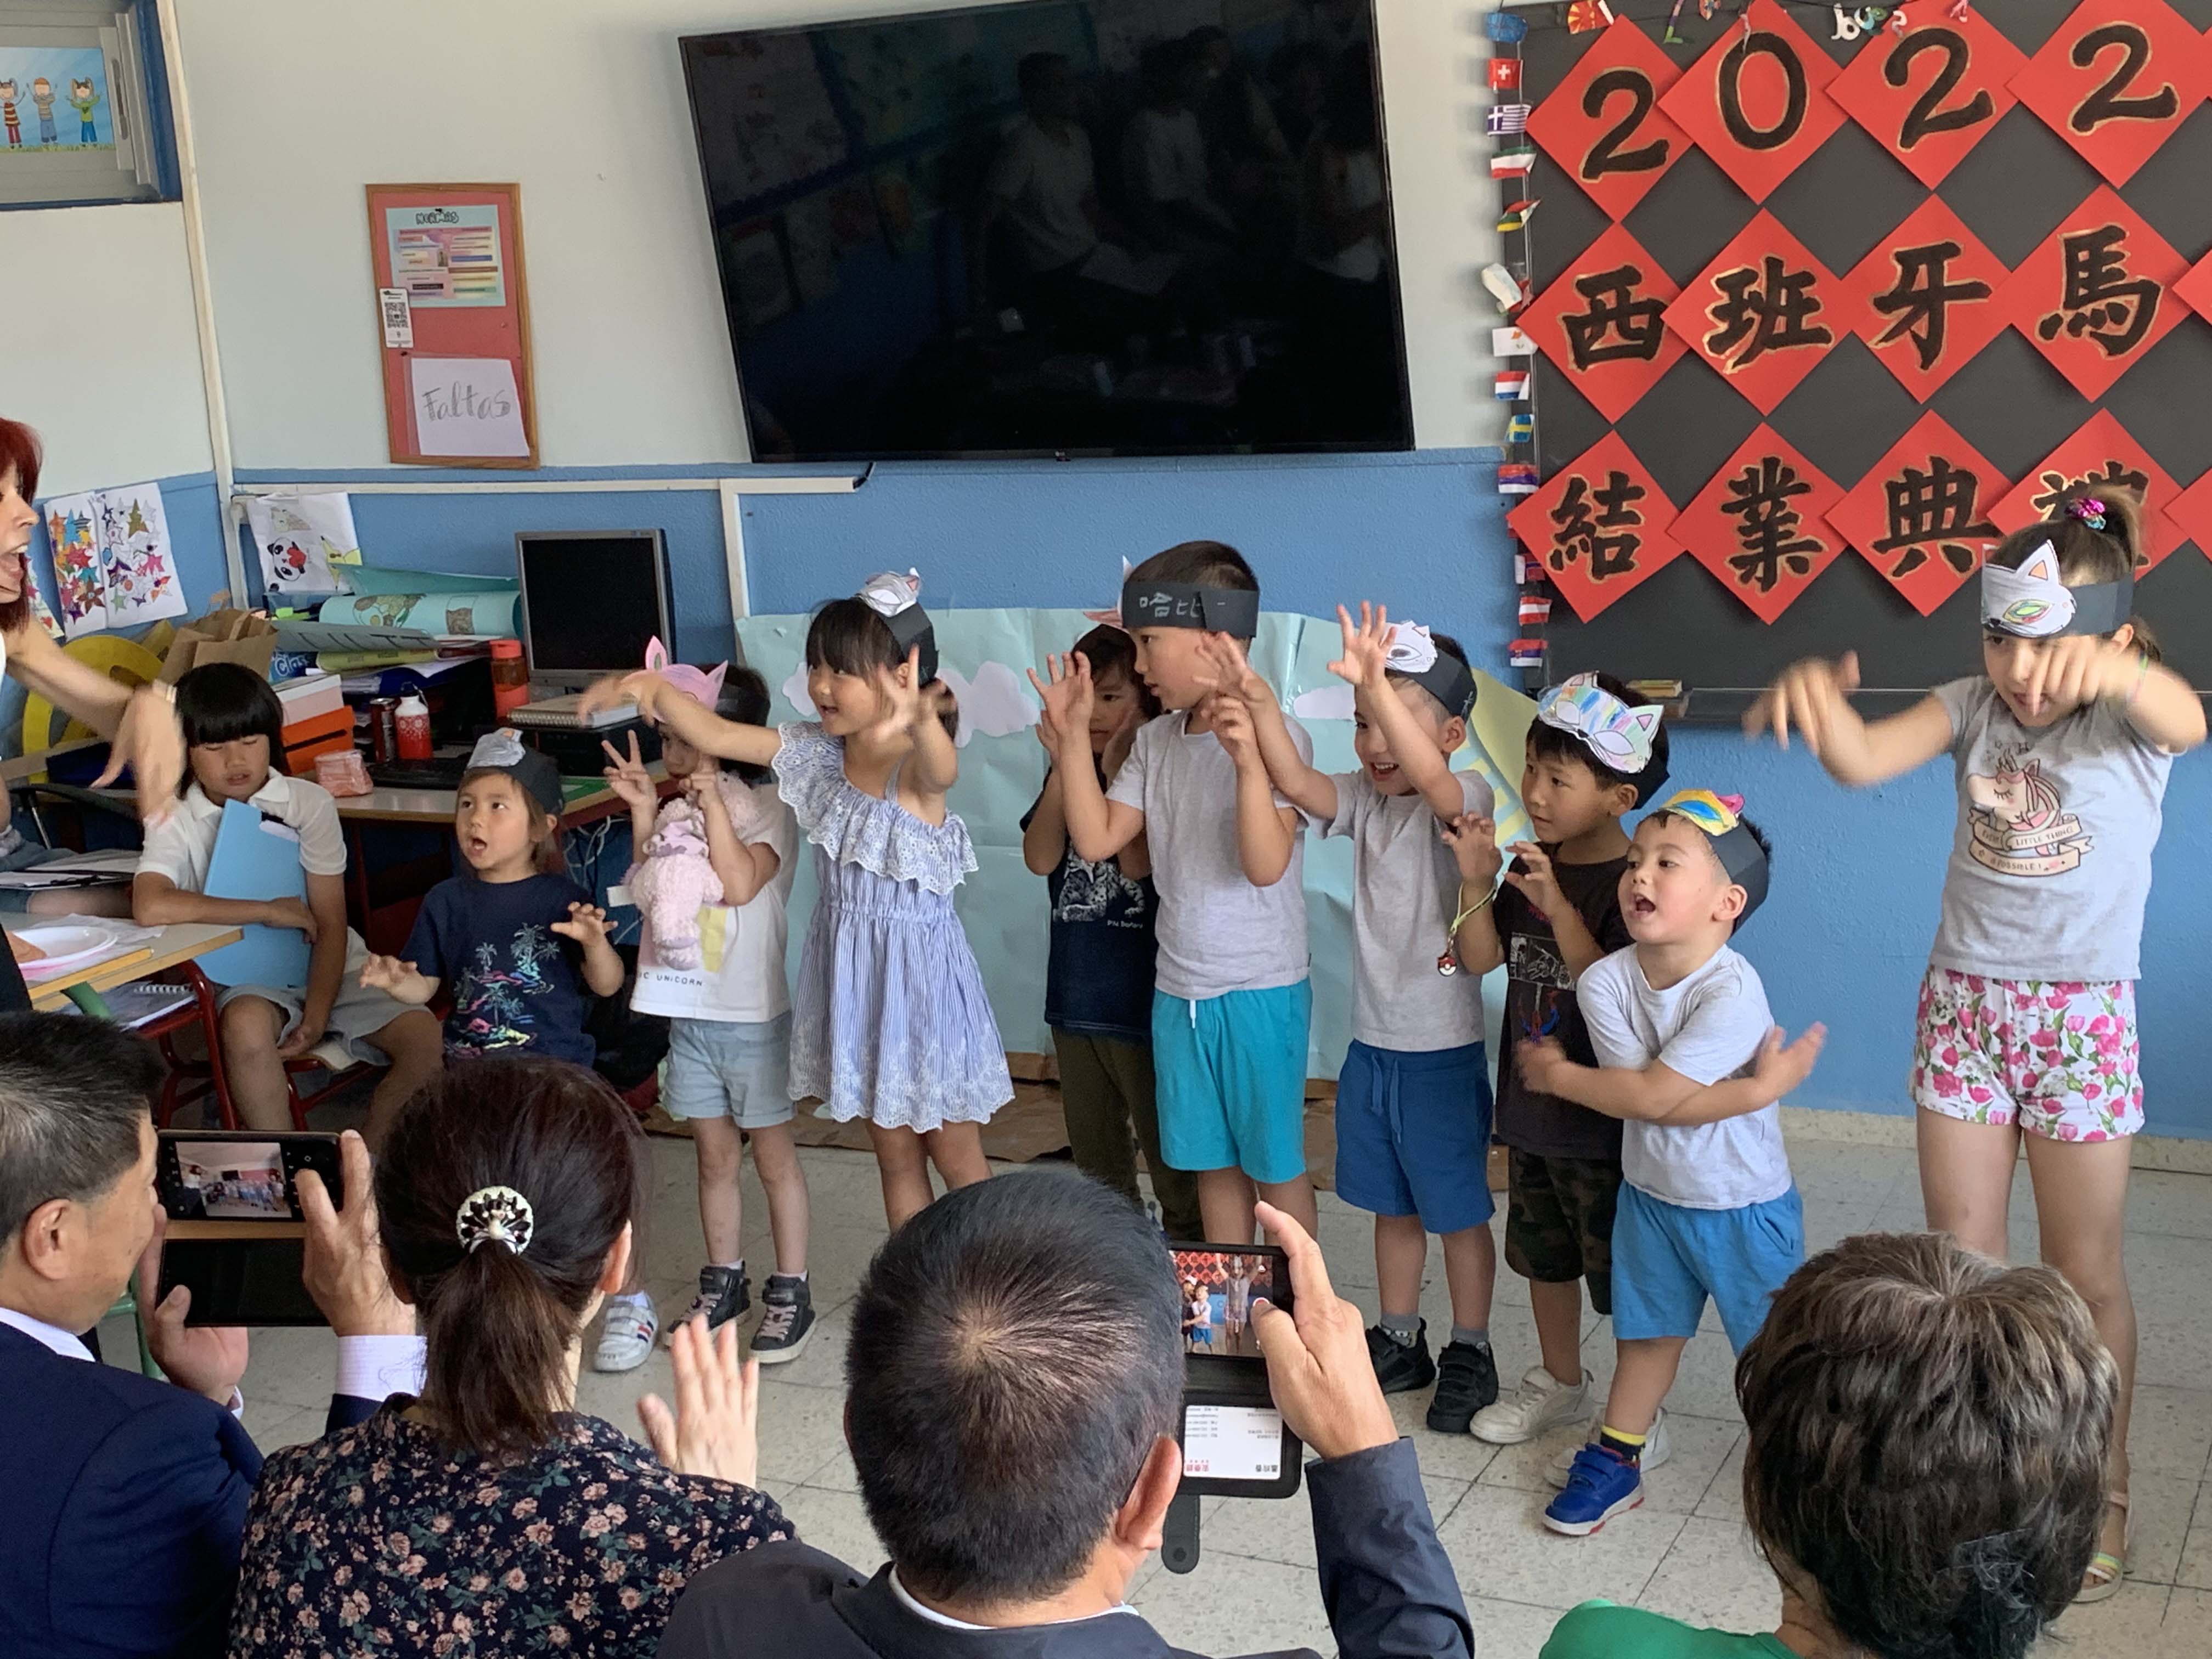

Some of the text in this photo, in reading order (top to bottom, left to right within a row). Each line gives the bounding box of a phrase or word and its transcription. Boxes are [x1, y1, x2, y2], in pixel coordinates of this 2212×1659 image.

[1580, 22, 2180, 183] 2022
[1561, 225, 2163, 374] 西班牙馬
[422, 380, 511, 422] Faltas
